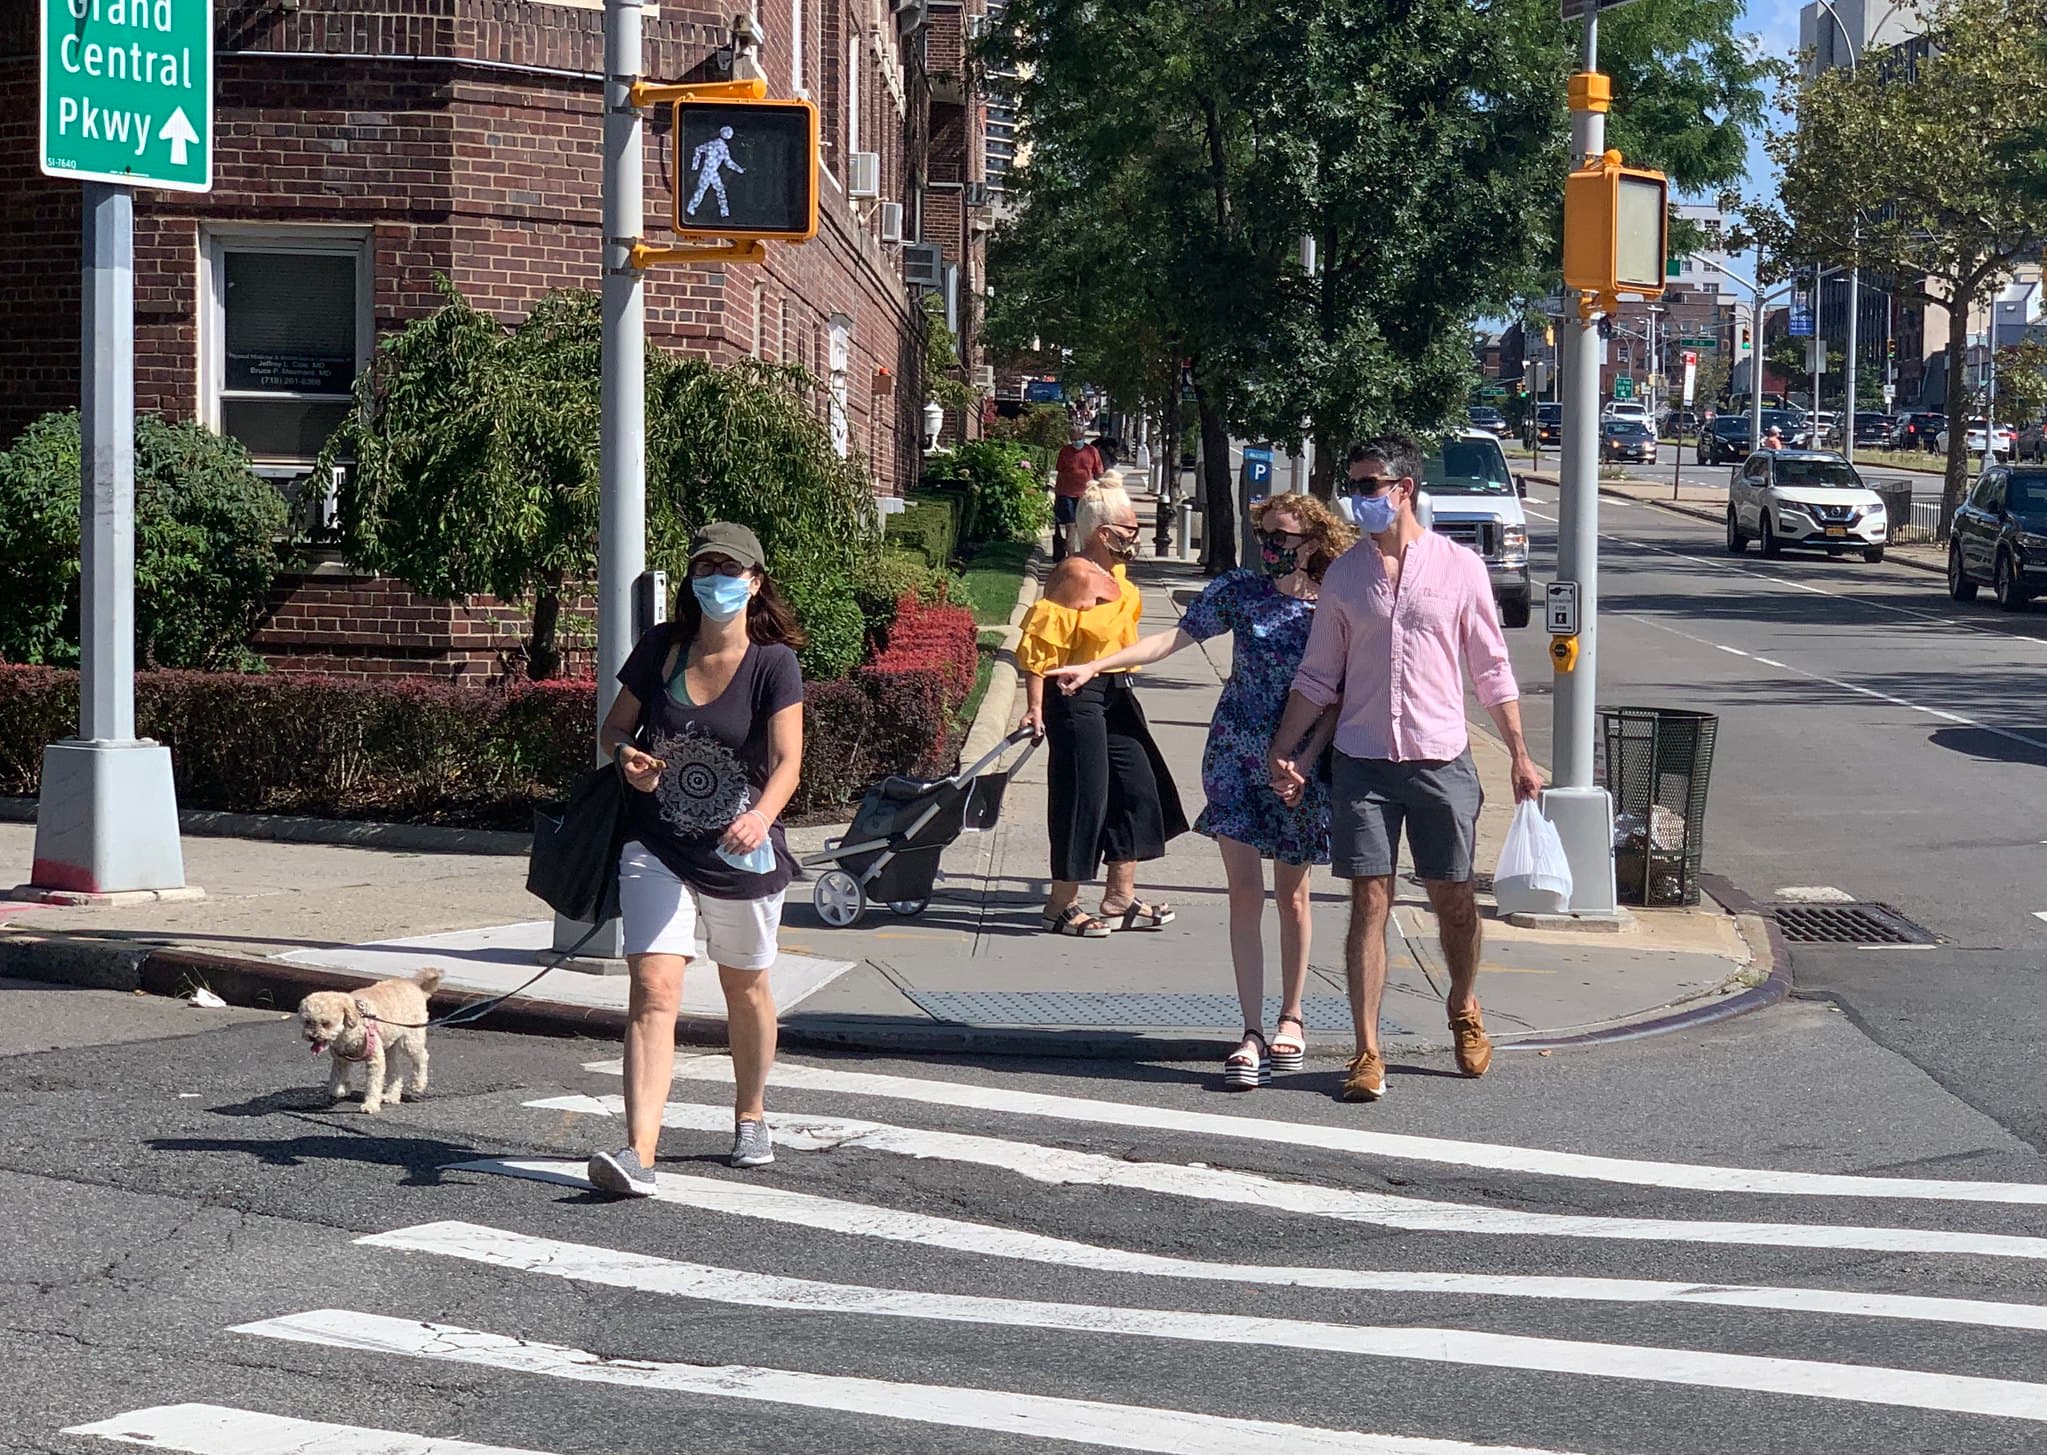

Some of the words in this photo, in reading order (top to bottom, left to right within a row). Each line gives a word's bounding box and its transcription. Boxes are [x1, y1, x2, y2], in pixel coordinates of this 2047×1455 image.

[60, 33, 192, 89] Central
[59, 96, 152, 156] Pkwy
[1255, 464, 1266, 480] P
